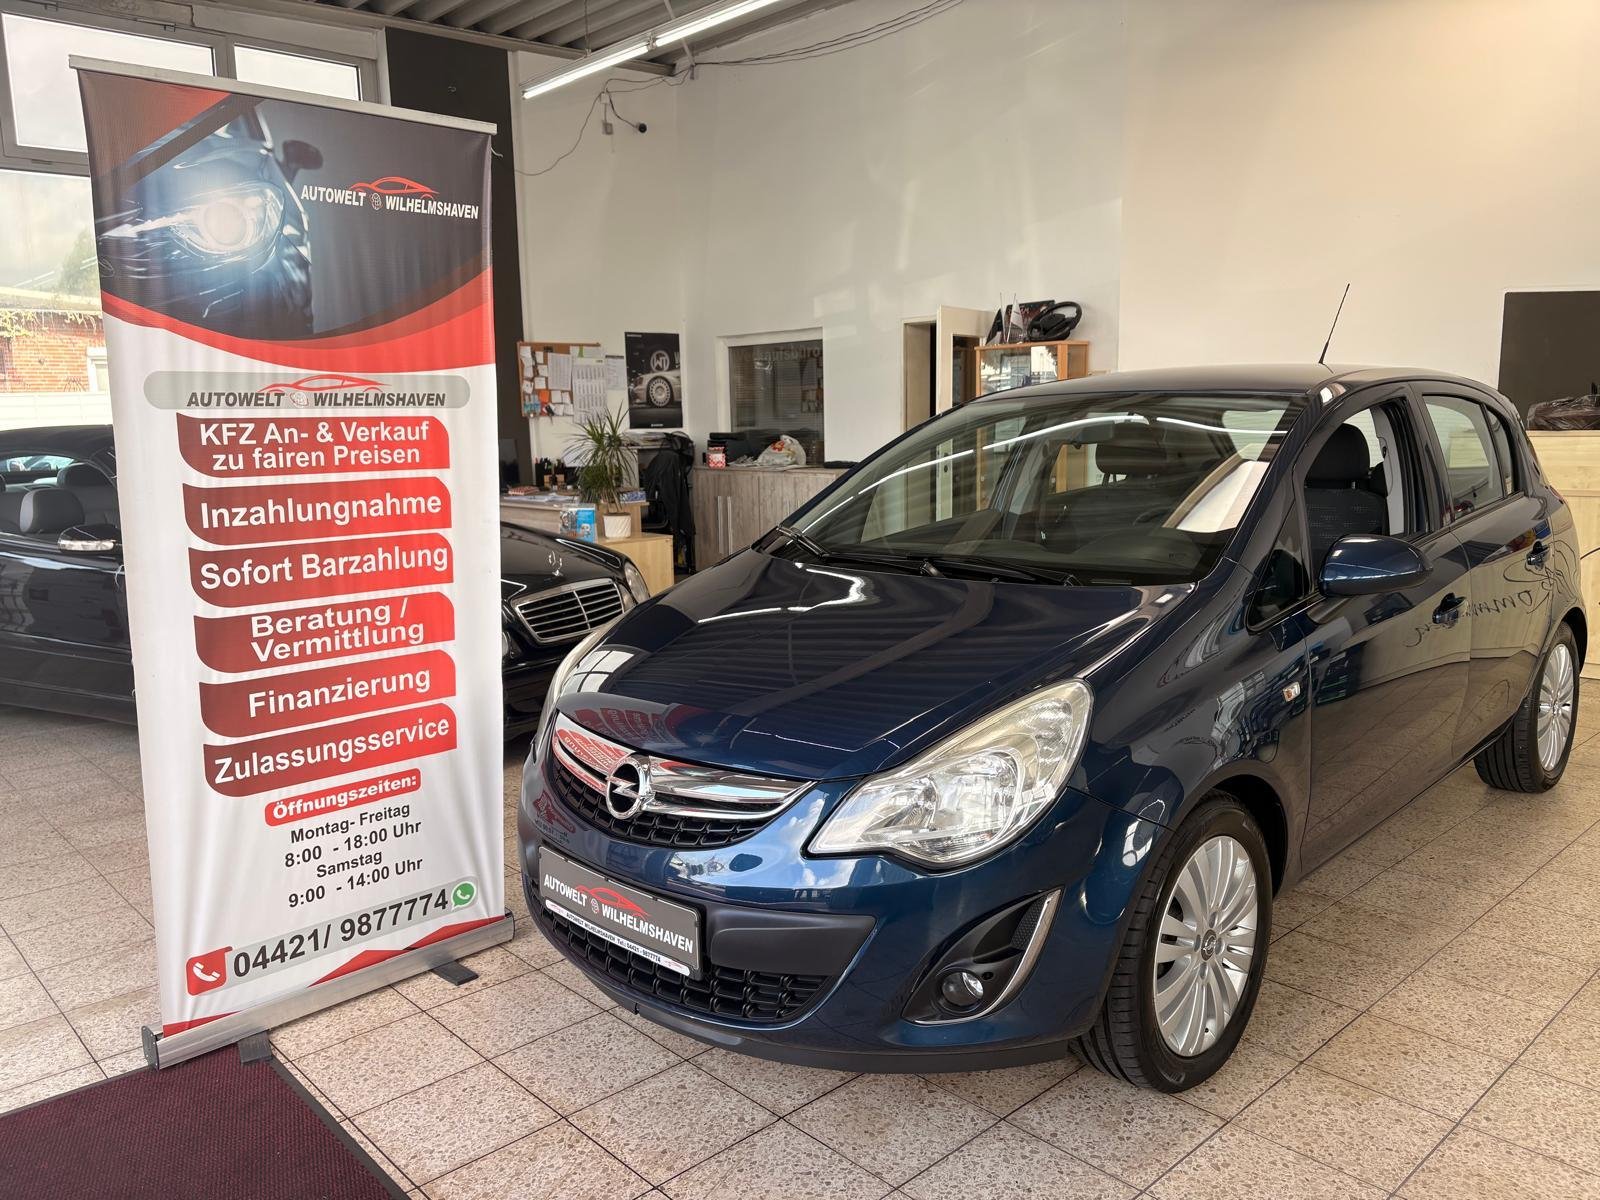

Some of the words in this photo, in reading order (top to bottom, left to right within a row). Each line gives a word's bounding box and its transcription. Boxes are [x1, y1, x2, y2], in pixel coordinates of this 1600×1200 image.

[301, 184, 366, 206] AUTOWELT
[386, 195, 479, 219] WILHELMSHAVEN
[187, 392, 285, 407] AUTOWELT
[313, 392, 446, 407] WILHELMSHAVEN
[199, 423, 257, 446] KFZ
[263, 423, 309, 445] An-
[316, 421, 334, 443] &
[340, 420, 430, 443] Verkauf
[212, 451, 244, 471] zu
[252, 447, 325, 469] fairen
[333, 444, 420, 466] Preisen
[200, 492, 442, 529] Inzahlungnahme
[200, 556, 292, 590] Sofort
[301, 545, 448, 579] Barzahlung
[250, 604, 391, 638] Beratung
[400, 597, 409, 618] /
[250, 622, 425, 663] Vermittlung
[249, 669, 431, 718] Finanzierung
[214, 717, 450, 785] Zulassungsservice
[272, 774, 417, 820] Öffnungszeiten:
[284, 845, 322, 868] 8:00
[344, 828, 388, 852] 18:00
[393, 820, 422, 838] Uhr
[290, 818, 355, 844] Montag-
[359, 804, 411, 826] Freitag
[288, 885, 326, 908] 9:00
[347, 866, 390, 891] 14:00
[395, 857, 423, 876] Uhr
[316, 850, 383, 878] Samstag
[233, 924, 332, 978] 04421/
[340, 888, 449, 942] 9877774
[543, 874, 587, 907] AUTOWELT
[601, 903, 694, 954] WILHELMSHAVEN
